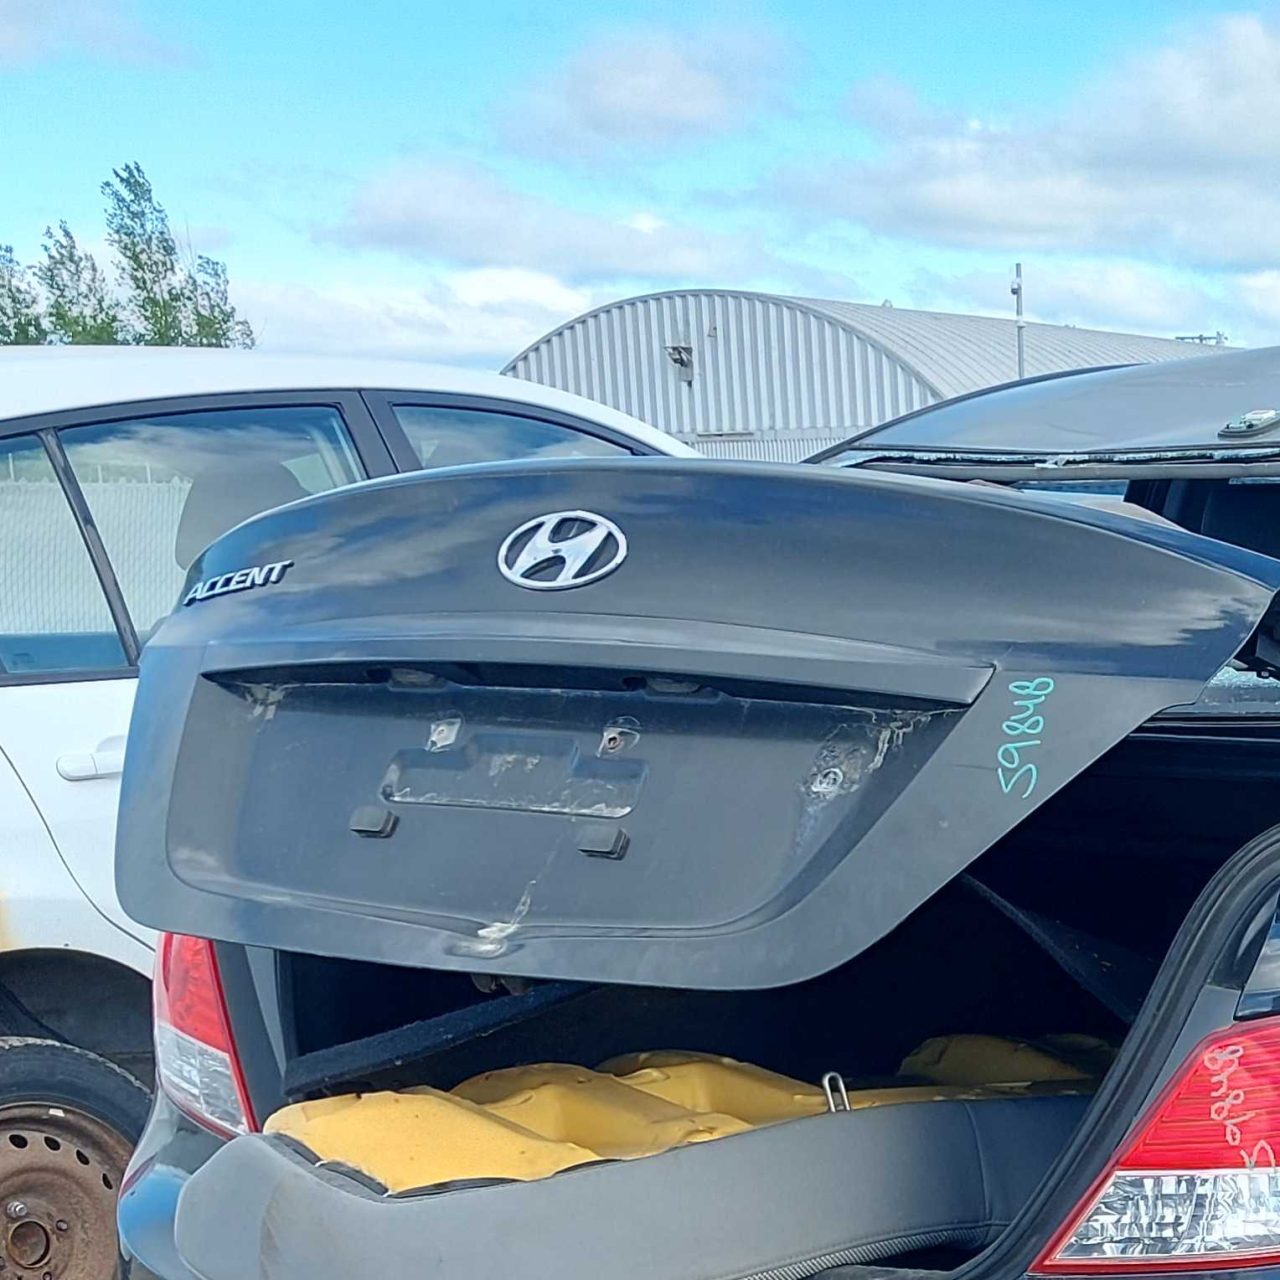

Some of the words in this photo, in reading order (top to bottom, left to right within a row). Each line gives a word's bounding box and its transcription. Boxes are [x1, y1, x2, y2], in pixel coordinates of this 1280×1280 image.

[182, 560, 295, 607] ACCENT
[997, 676, 1056, 799] 59848
[1203, 1044, 1277, 1173] 59848
